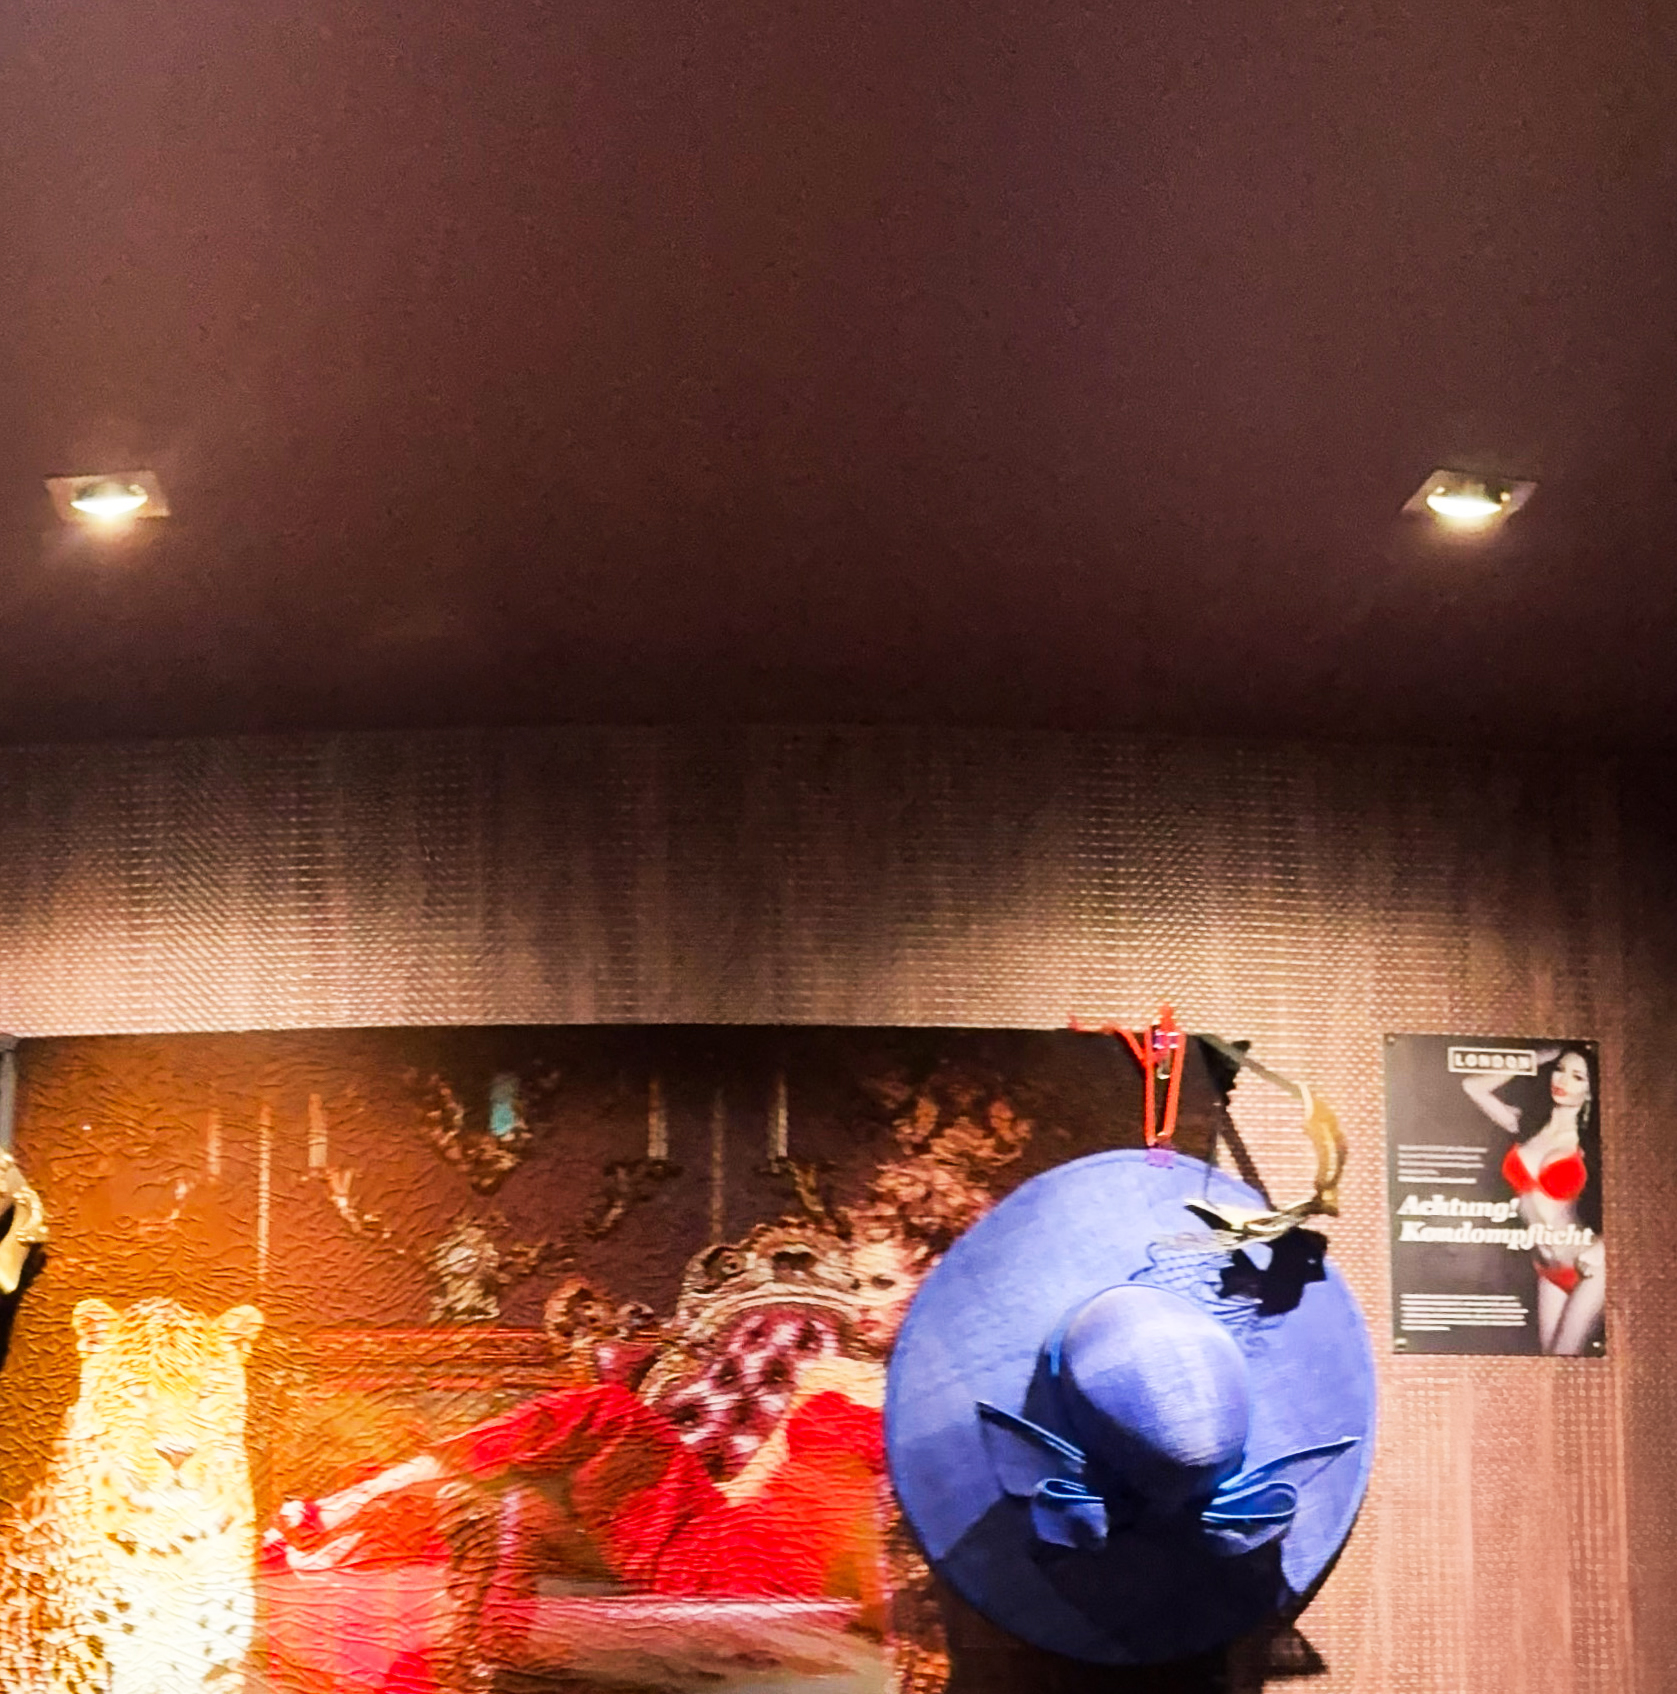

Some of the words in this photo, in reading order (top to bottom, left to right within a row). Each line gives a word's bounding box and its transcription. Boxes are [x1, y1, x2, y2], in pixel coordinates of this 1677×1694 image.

[1455, 1052, 1531, 1070] LONDON
[1397, 1195, 1519, 1222] Achtung!
[1399, 1221, 1594, 1250] Kondompflicht
